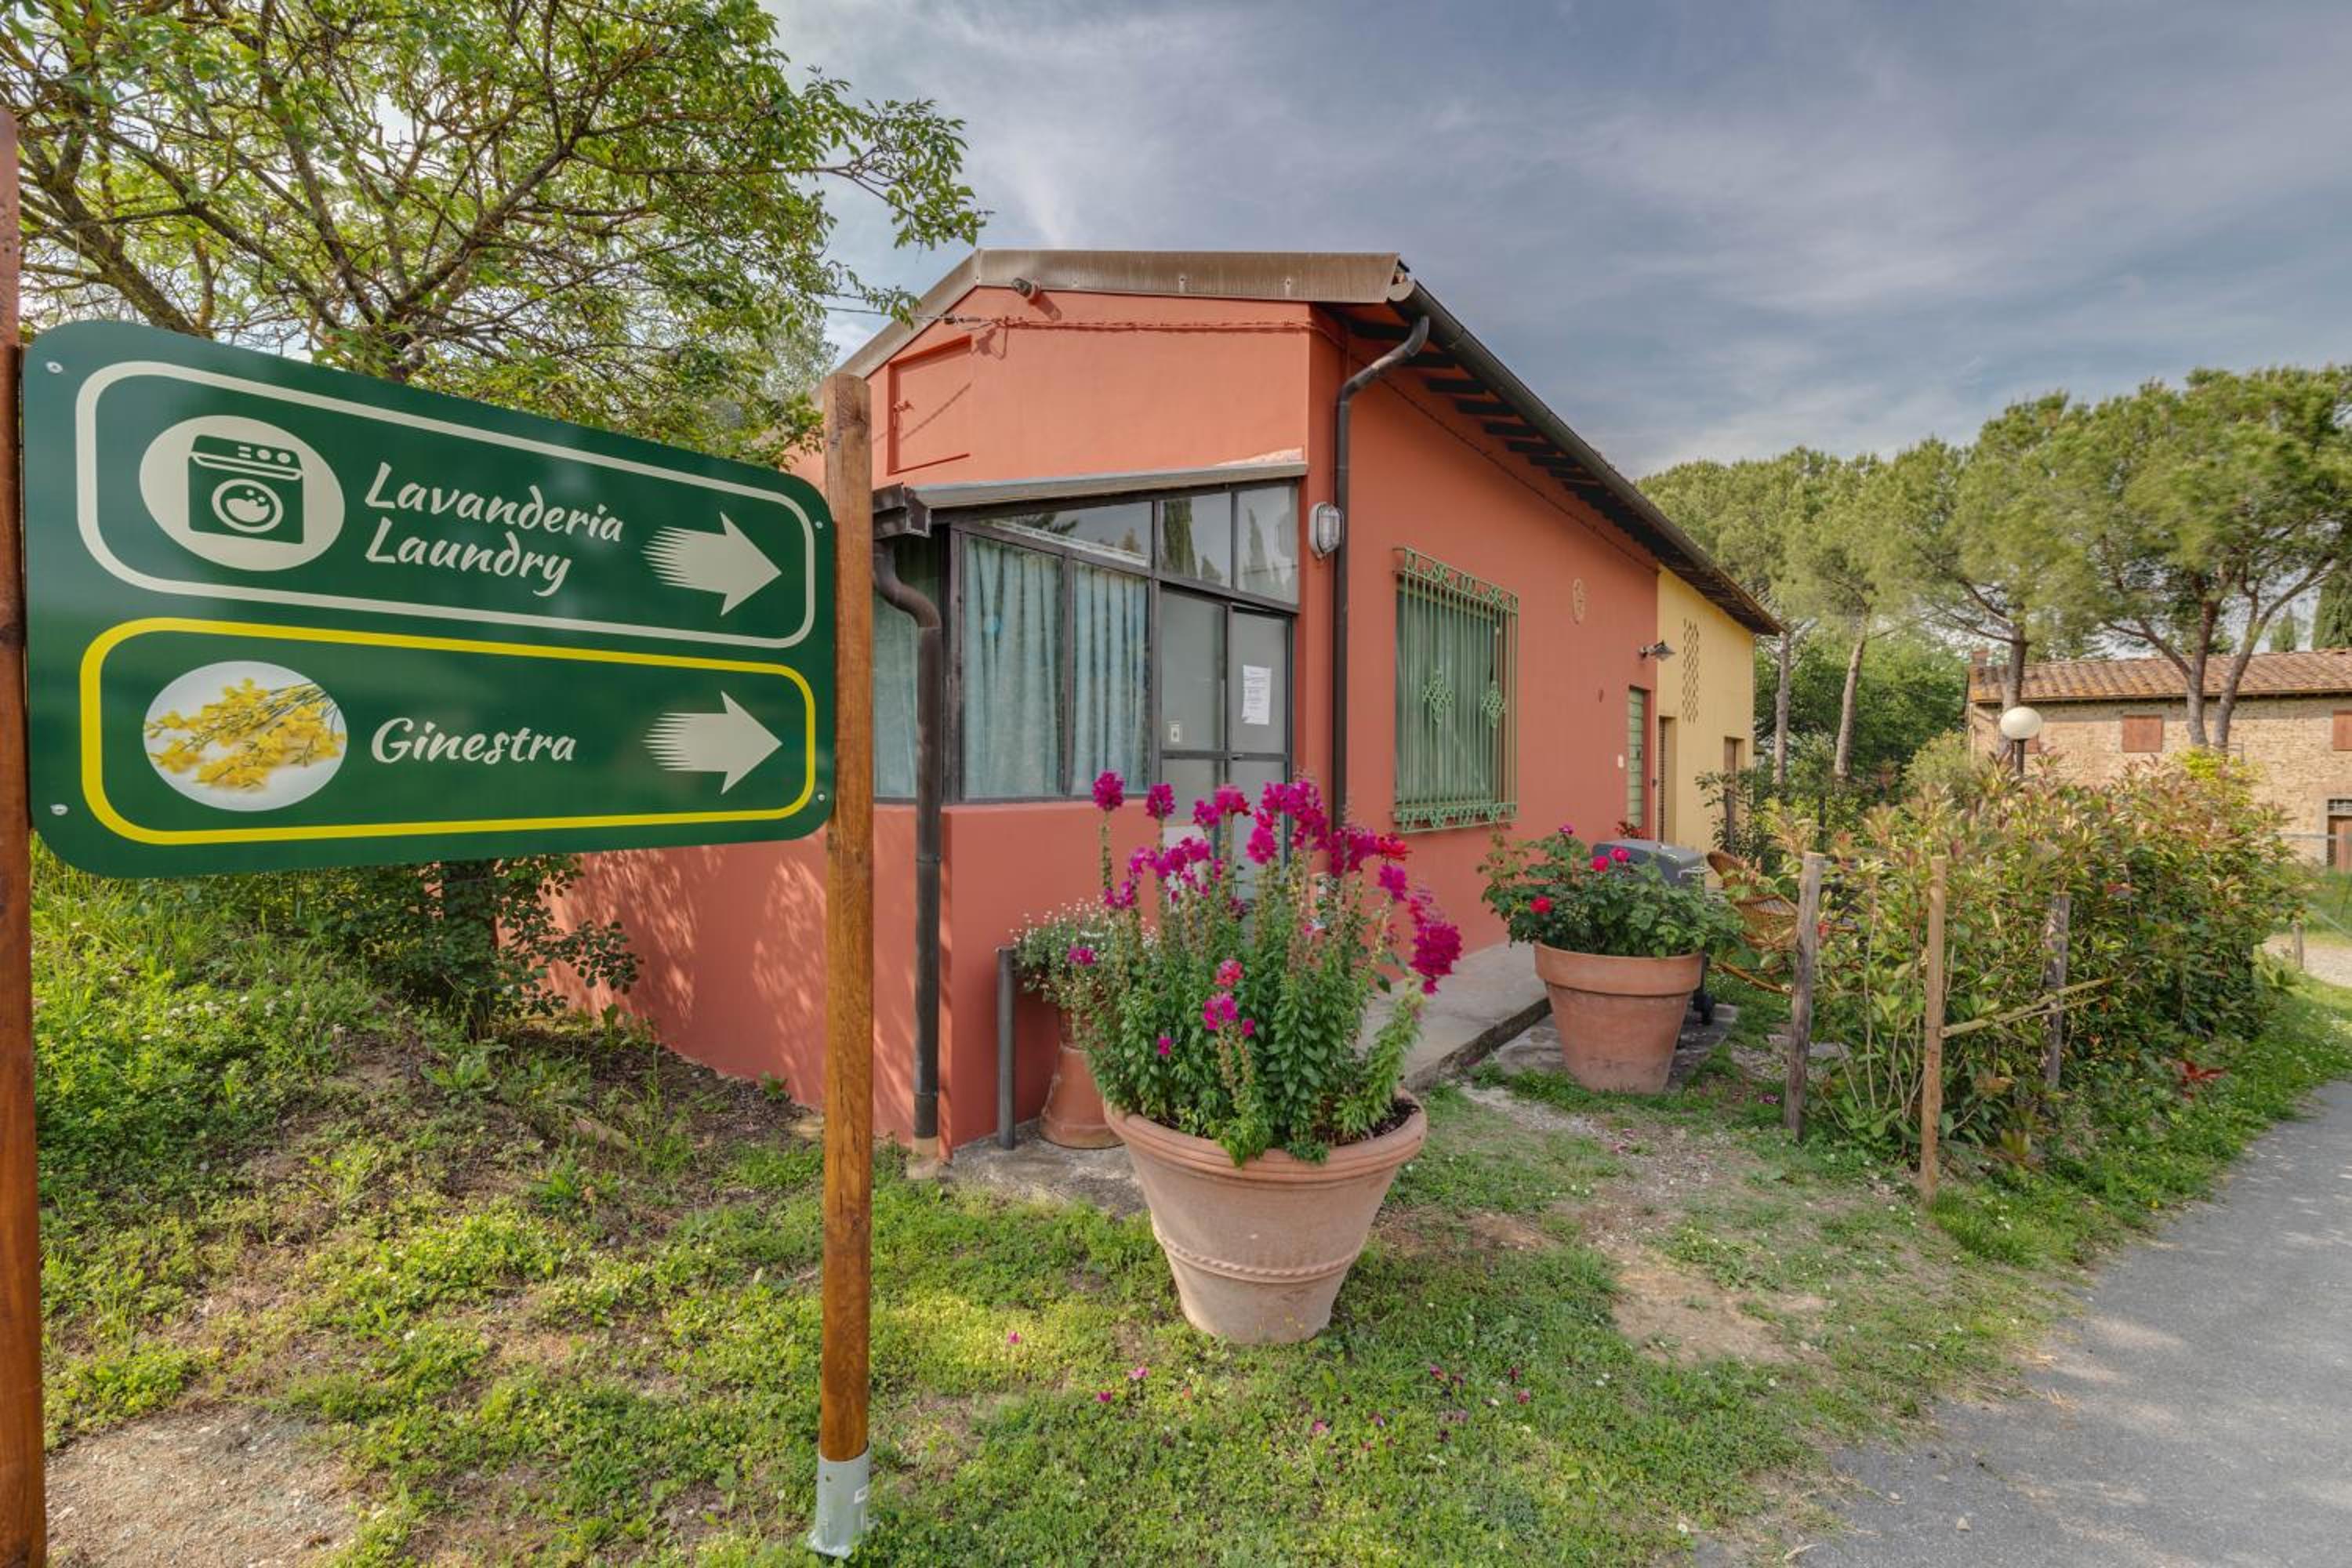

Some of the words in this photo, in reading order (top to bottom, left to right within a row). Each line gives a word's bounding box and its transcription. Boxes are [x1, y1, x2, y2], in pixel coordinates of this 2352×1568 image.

[365, 462, 624, 542] Lavanderia
[365, 517, 572, 597] Laundry
[371, 717, 576, 764] Ginestra
